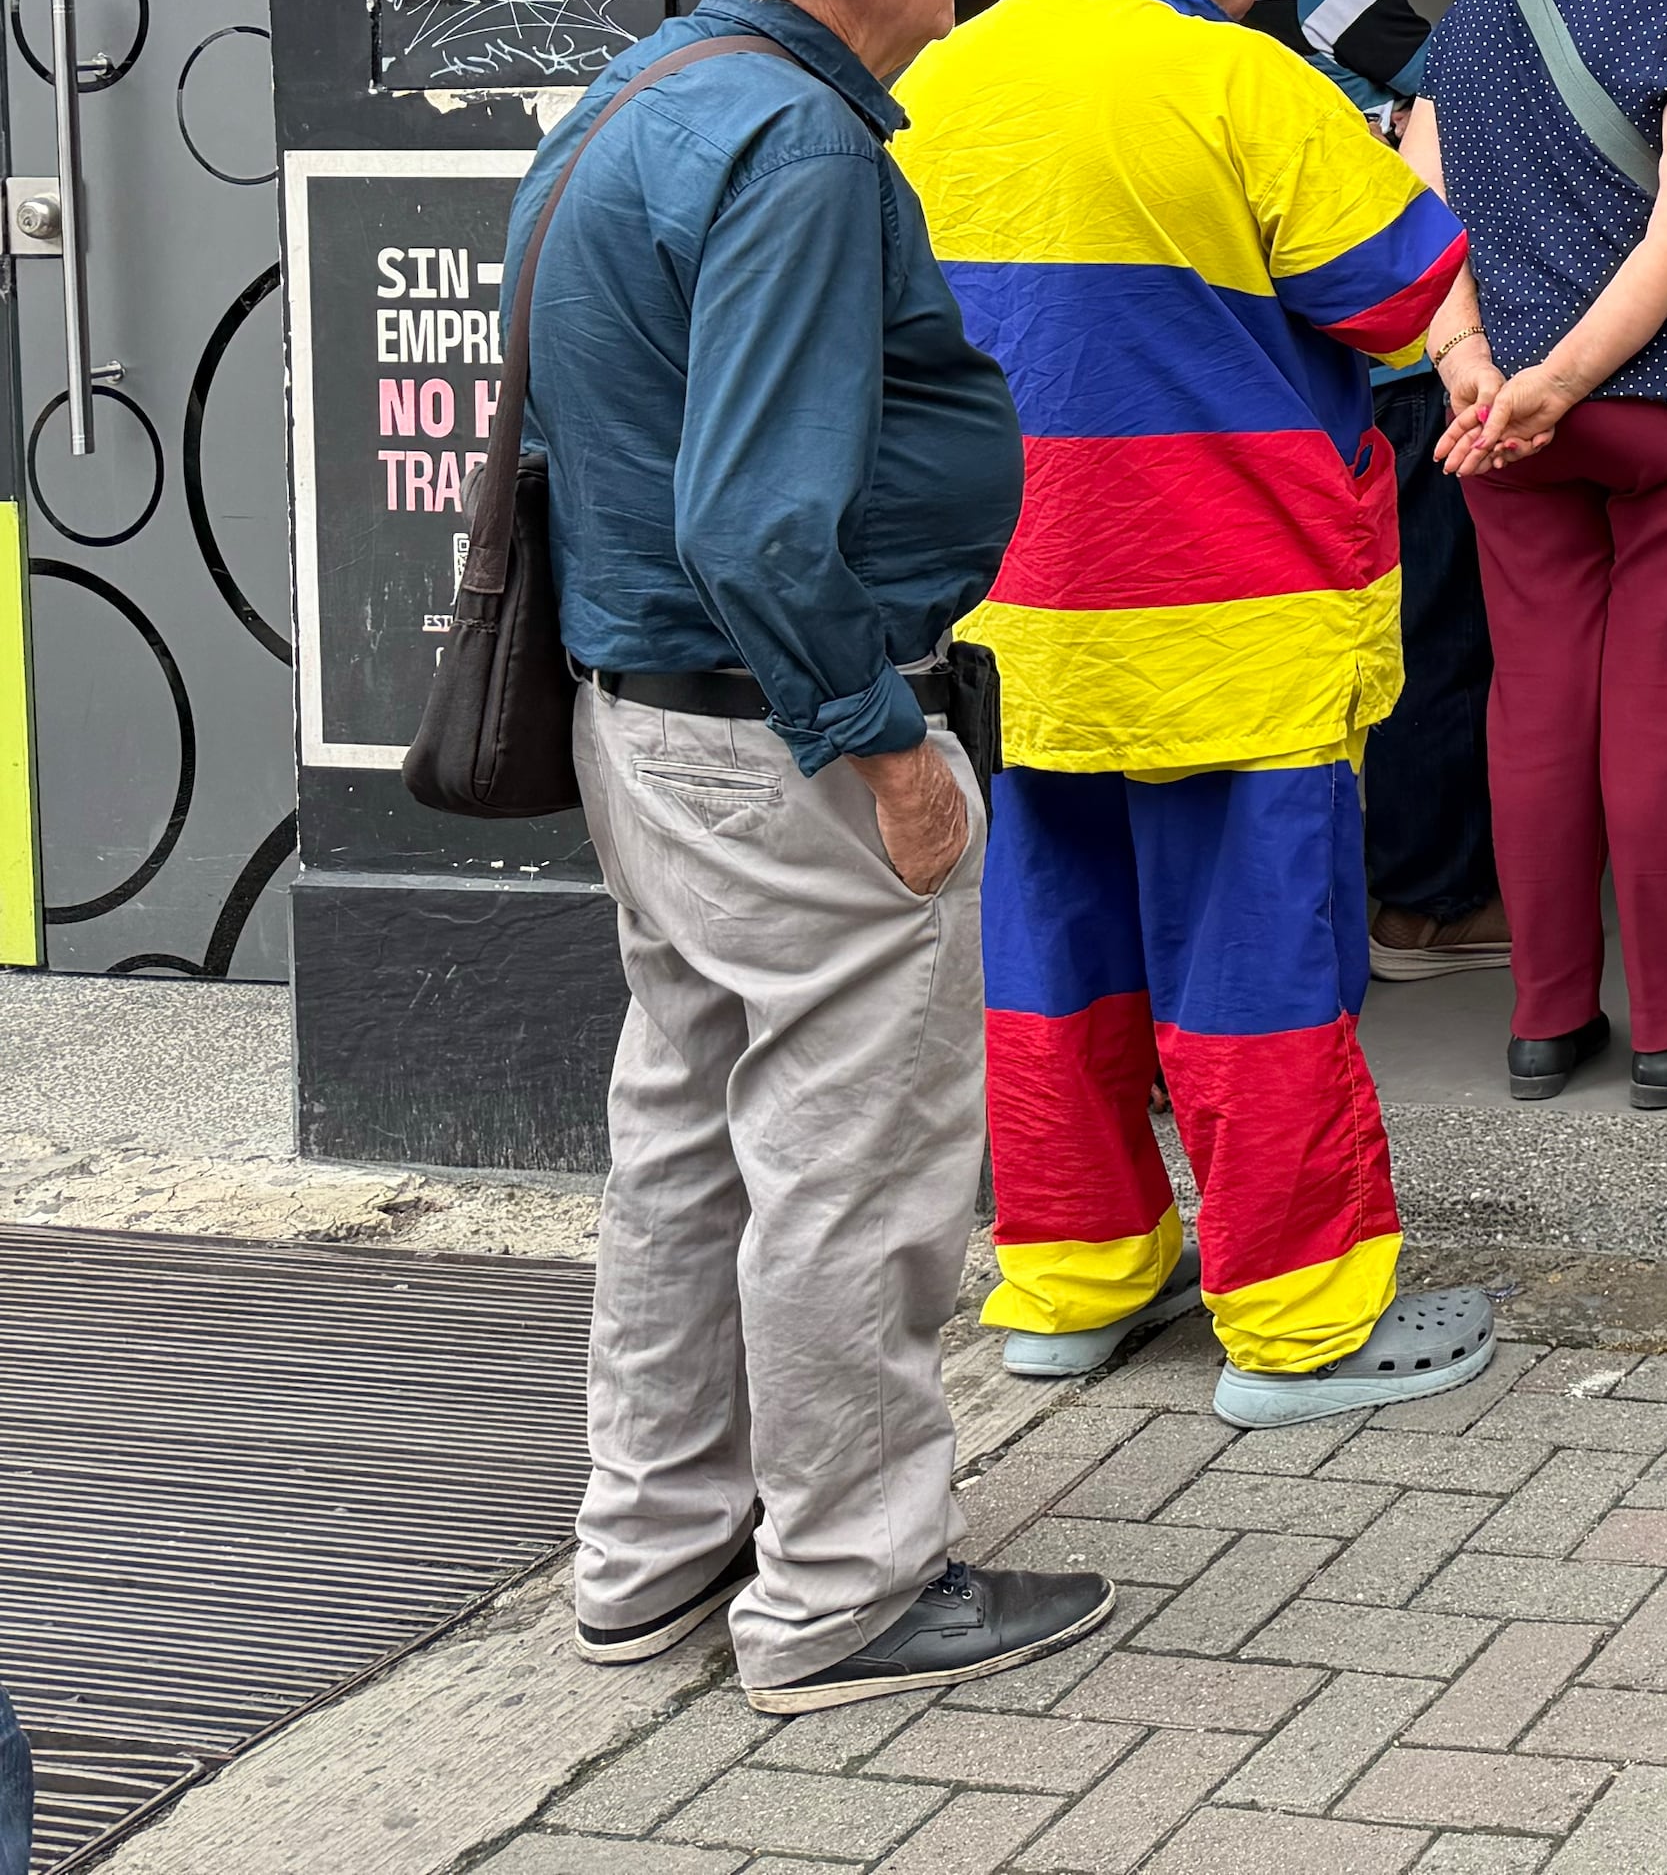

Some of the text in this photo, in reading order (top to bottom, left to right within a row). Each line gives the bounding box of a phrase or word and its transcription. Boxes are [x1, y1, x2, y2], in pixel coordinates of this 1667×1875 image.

[377, 309, 504, 364] EMPRE
[378, 378, 502, 438] NO H
[378, 450, 489, 513] TRA
